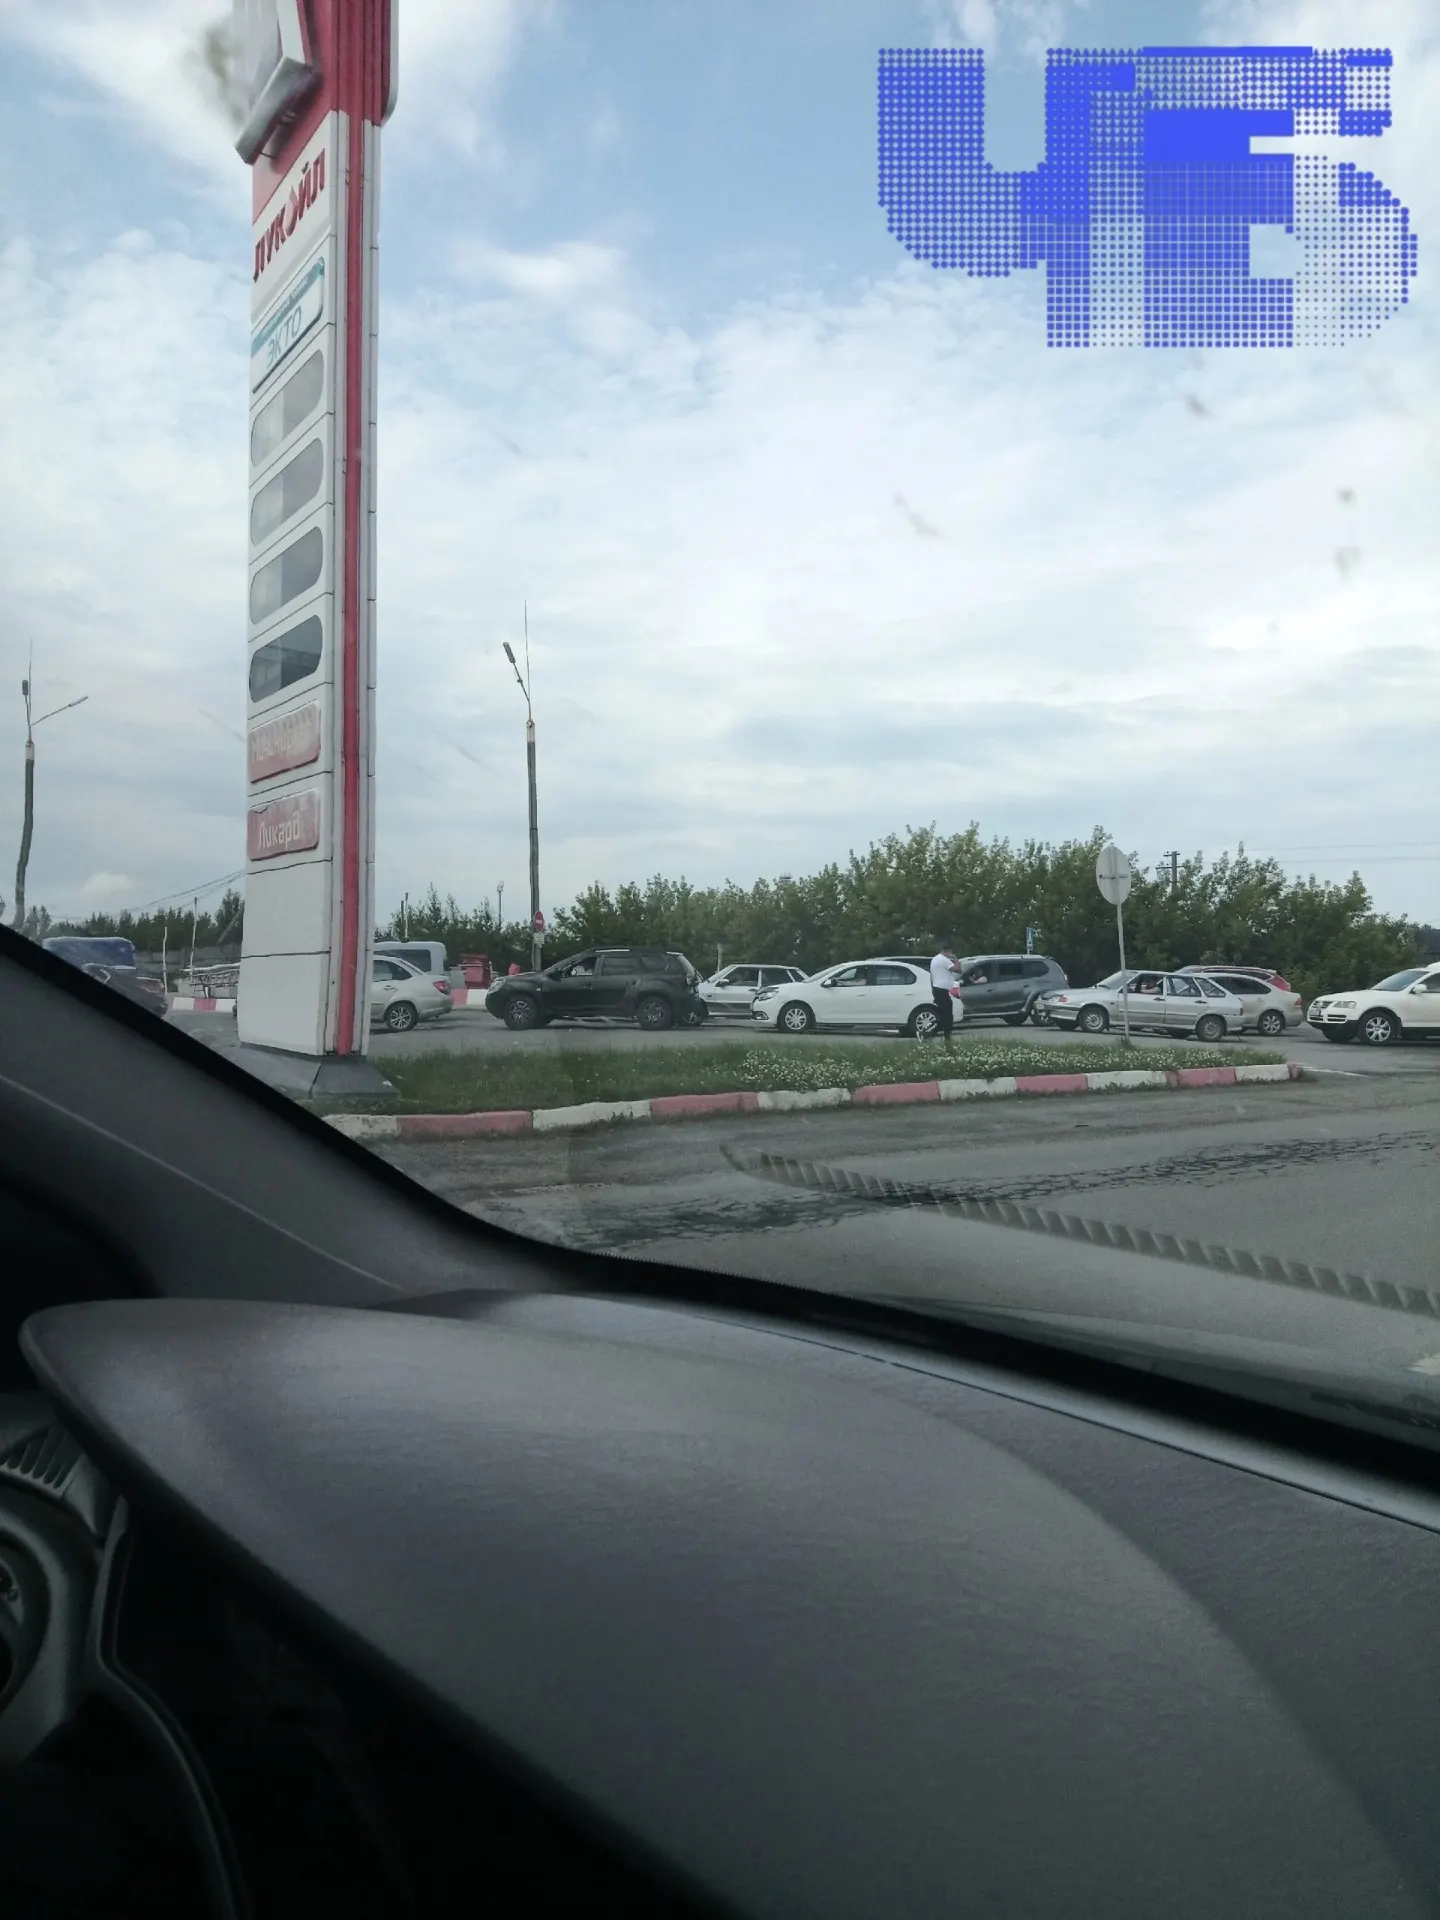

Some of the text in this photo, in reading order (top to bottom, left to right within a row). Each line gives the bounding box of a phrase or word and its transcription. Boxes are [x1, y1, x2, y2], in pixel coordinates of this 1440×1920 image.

[253, 148, 326, 283] ЛУКОЙЛ
[267, 306, 302, 370] ЭКТО
[257, 811, 301, 851] Ликард
